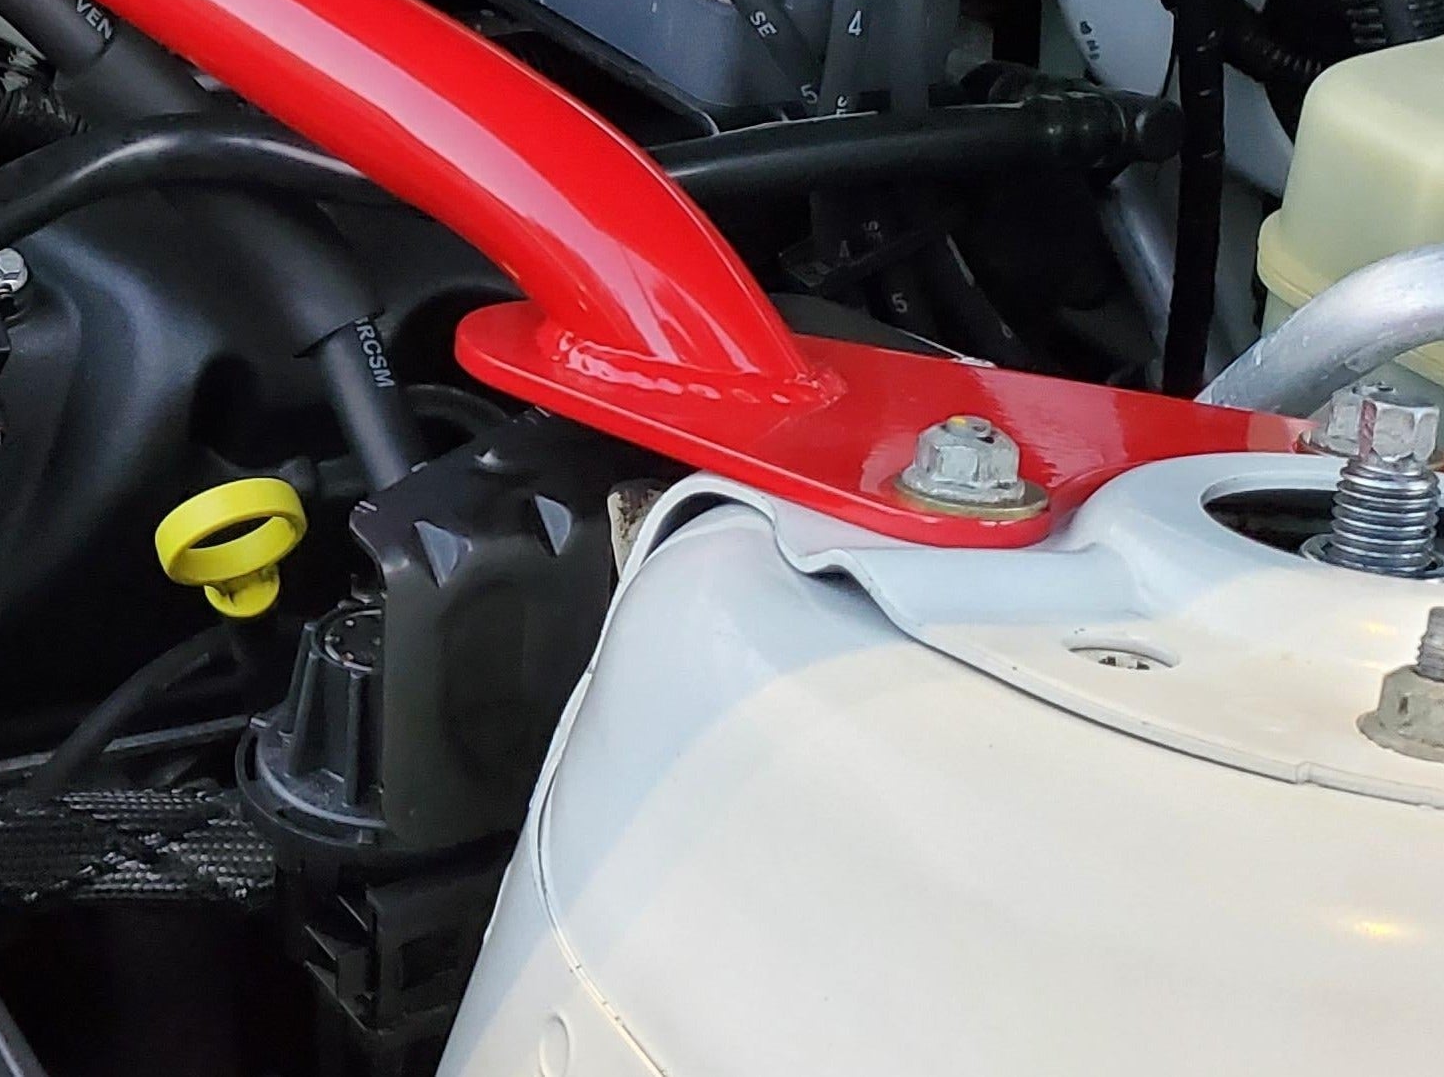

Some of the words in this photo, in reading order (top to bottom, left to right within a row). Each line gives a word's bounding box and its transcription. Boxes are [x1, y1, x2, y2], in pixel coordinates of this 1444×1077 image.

[749, 11, 777, 38] SE
[848, 10, 862, 36] 4
[800, 84, 818, 104] 5
[890, 292, 908, 313] 5
